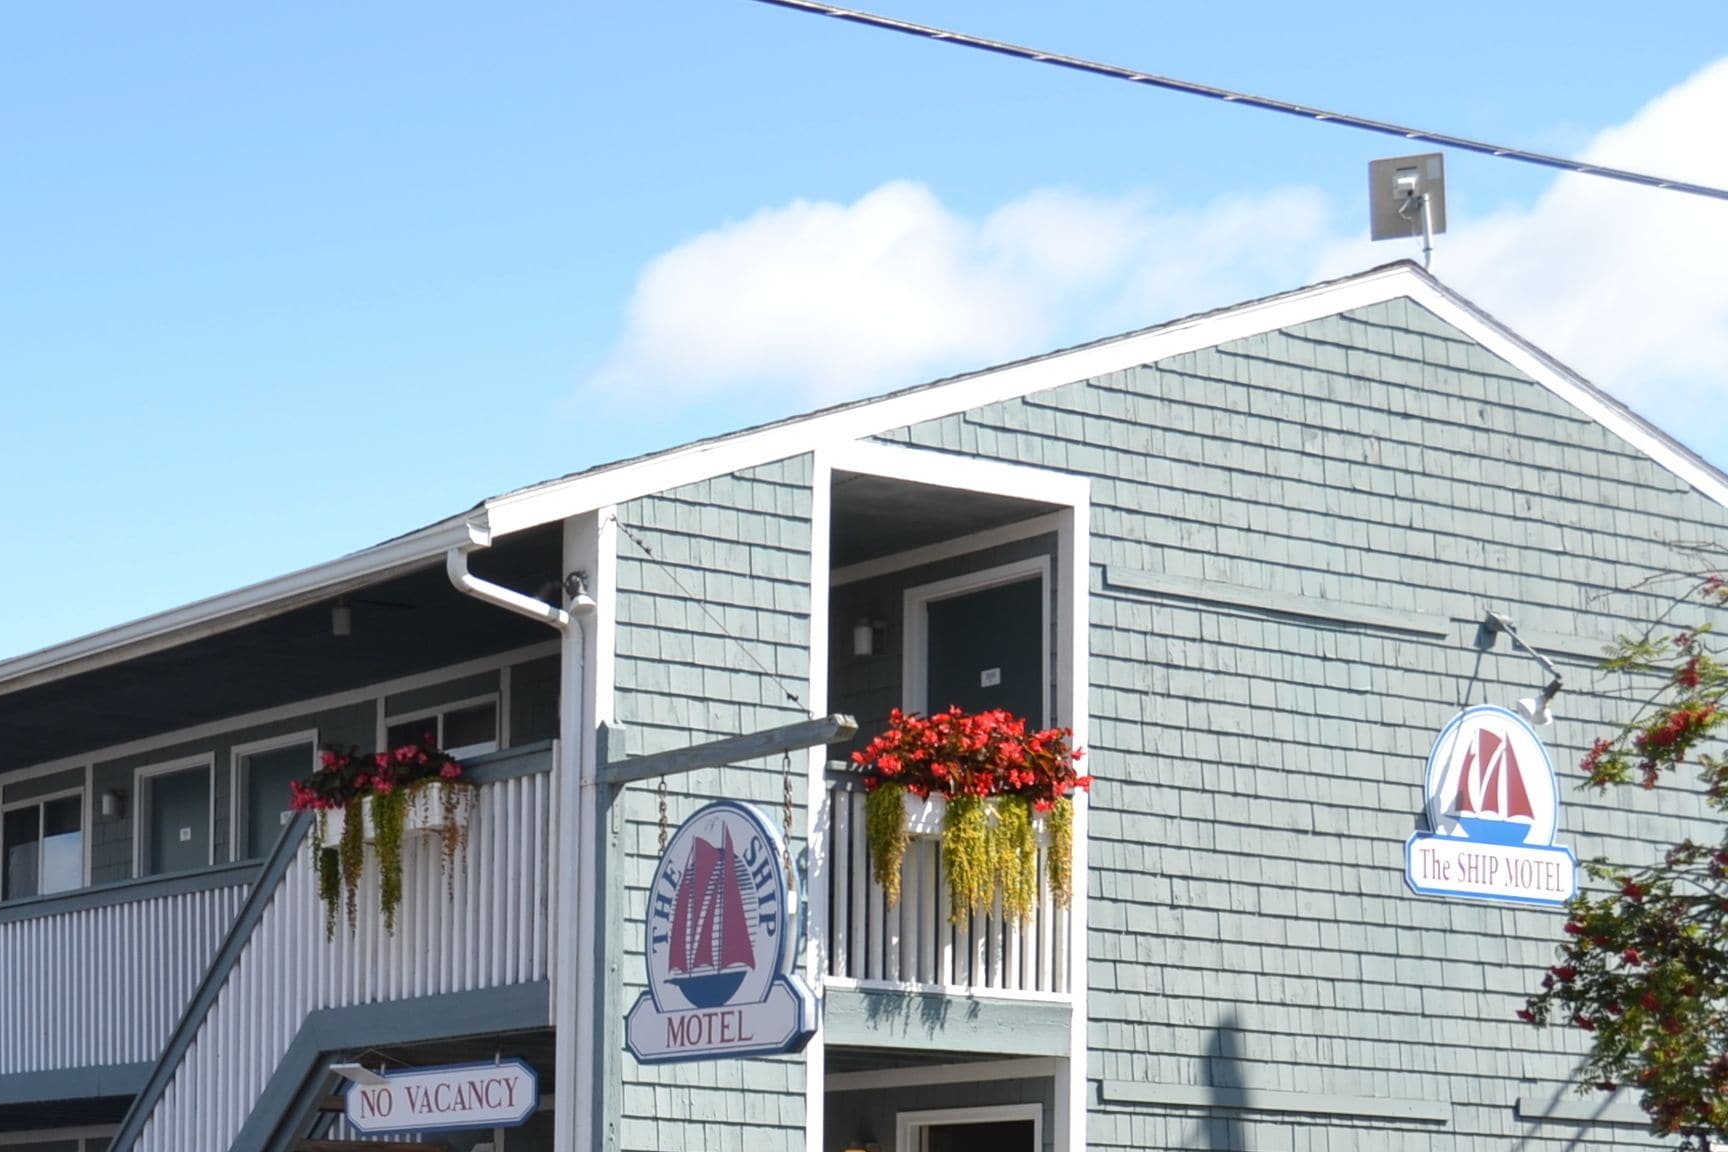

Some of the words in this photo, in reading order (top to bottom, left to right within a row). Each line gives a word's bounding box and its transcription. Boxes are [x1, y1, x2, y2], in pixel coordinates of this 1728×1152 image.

[1420, 848, 1450, 881] The
[1457, 852, 1499, 886] SHIP
[1504, 857, 1565, 893] MOTEL
[652, 860, 682, 953] THE
[743, 835, 776, 938] SHIP
[666, 1010, 754, 1048] MOTEL
[360, 1087, 393, 1119] NO
[404, 1077, 520, 1114] VACANCY
